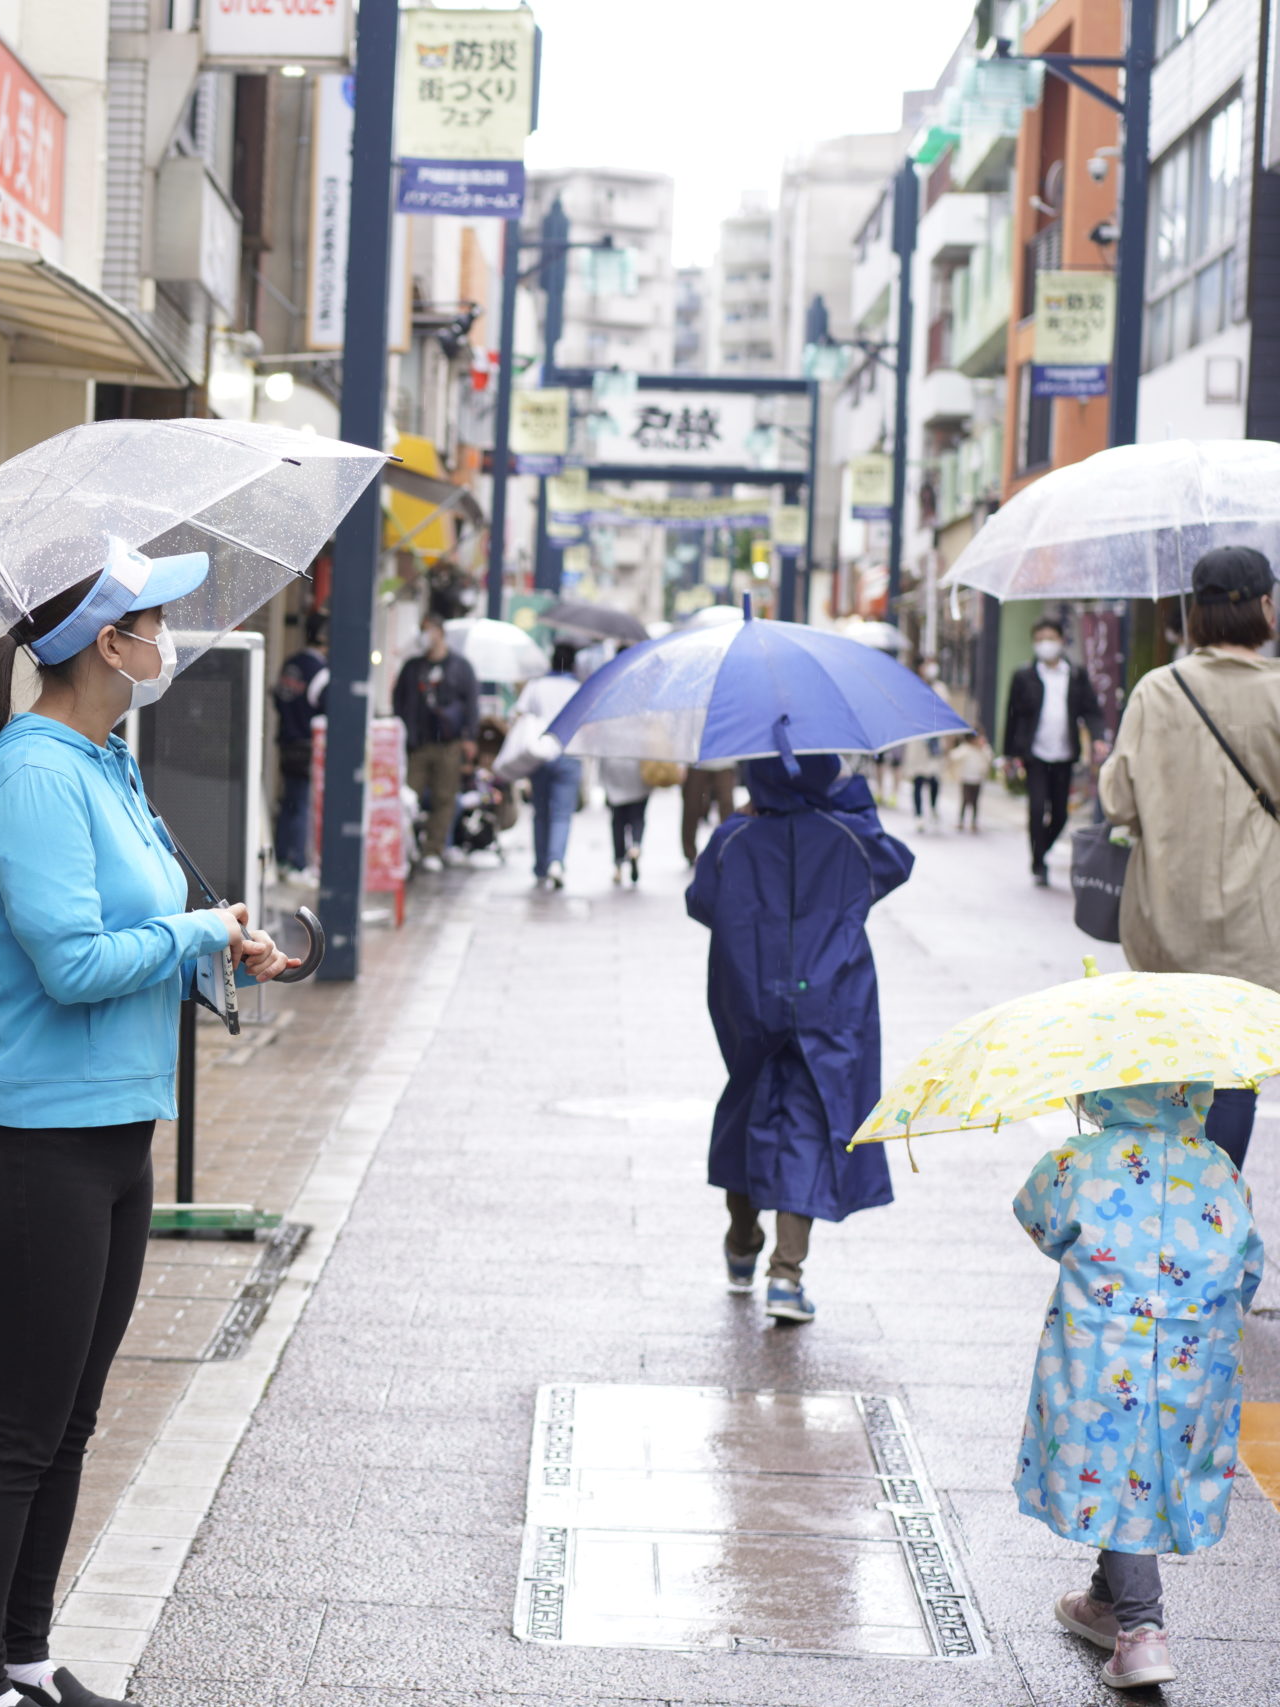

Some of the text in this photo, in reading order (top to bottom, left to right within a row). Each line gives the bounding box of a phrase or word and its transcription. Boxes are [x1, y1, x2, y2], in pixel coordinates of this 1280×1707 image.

[452, 40, 518, 72] 防災
[419, 77, 517, 104] 街づくり
[440, 107, 494, 127] フェア
